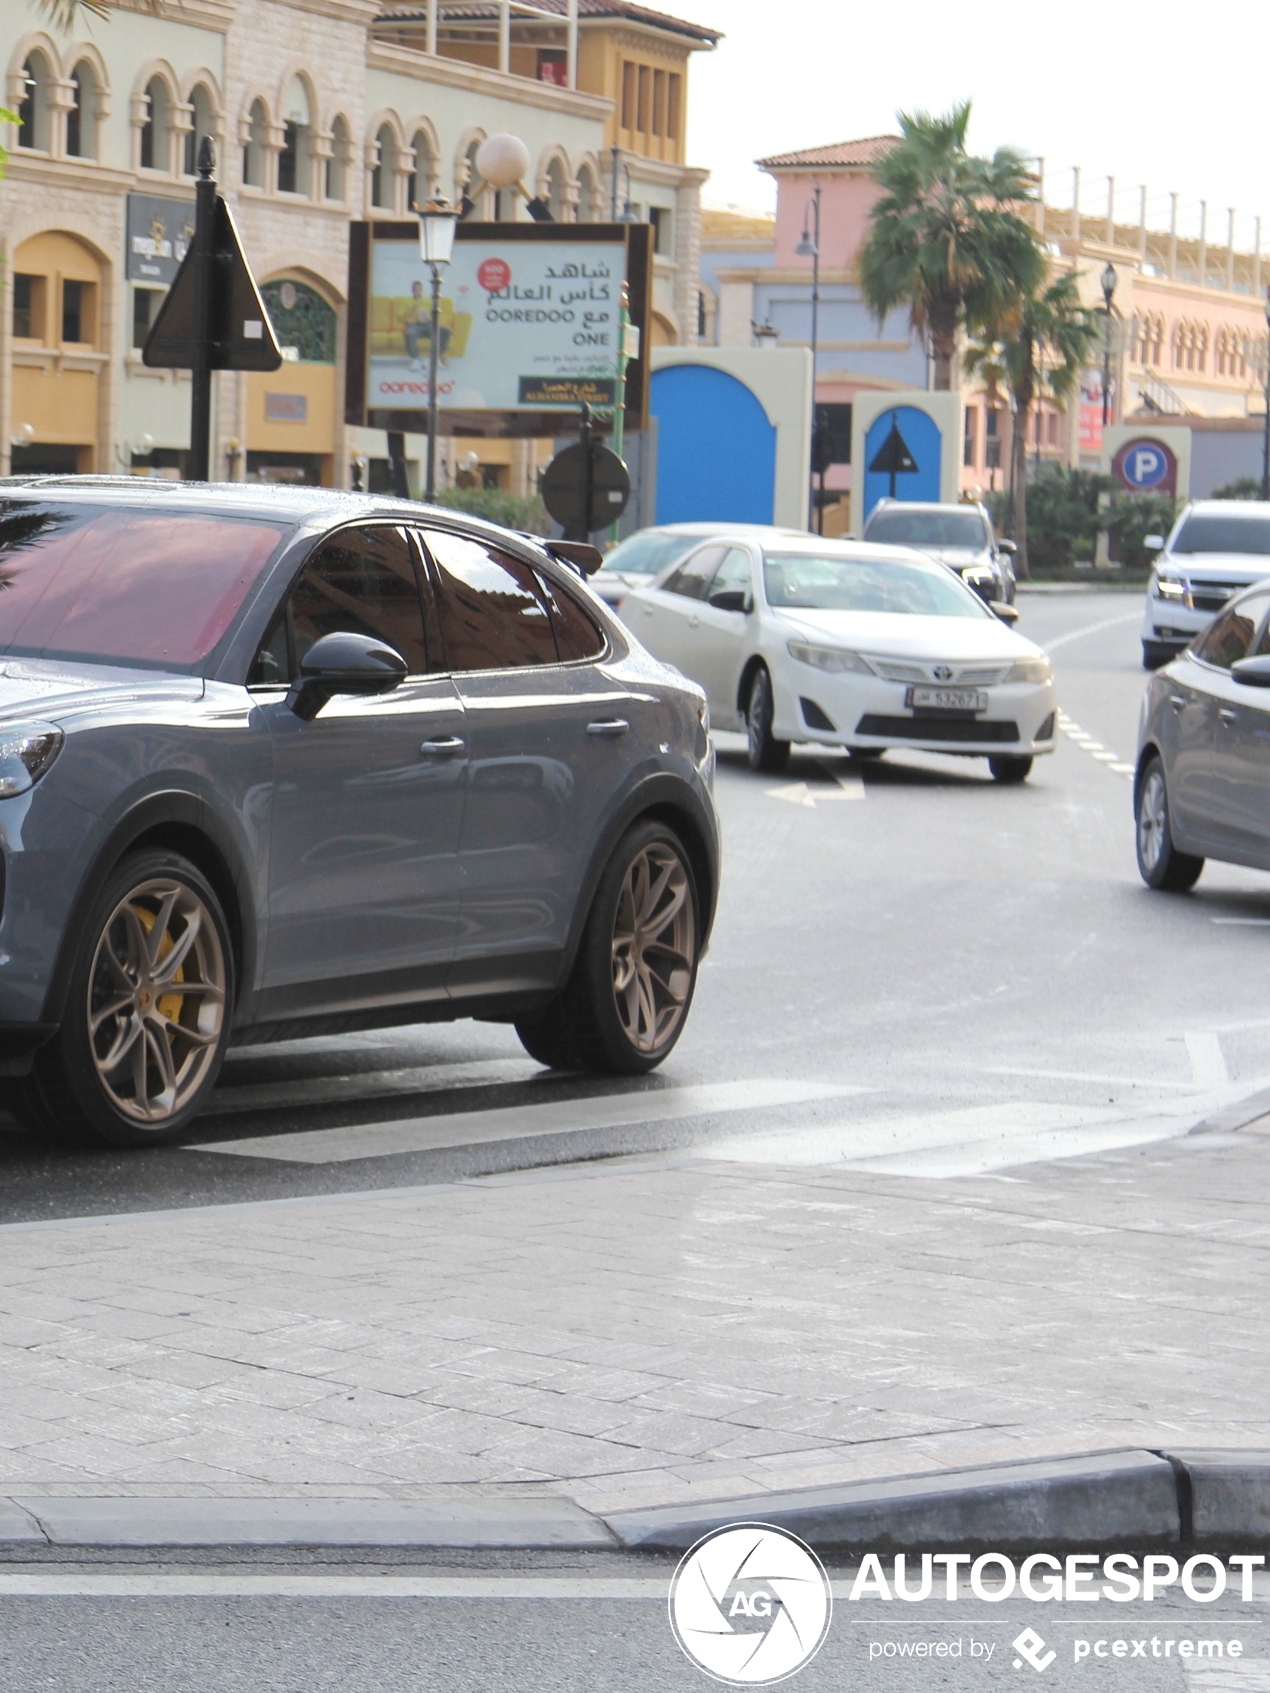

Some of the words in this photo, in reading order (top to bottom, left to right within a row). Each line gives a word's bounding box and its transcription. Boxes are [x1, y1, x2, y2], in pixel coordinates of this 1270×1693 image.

[545, 260, 610, 278] شاهد
[487, 285, 553, 305] العالم
[560, 281, 610, 304] كأس
[486, 309, 575, 323] OOREDOO
[582, 310, 610, 329] مع
[573, 333, 610, 346] ONE
[1135, 451, 1158, 482] P
